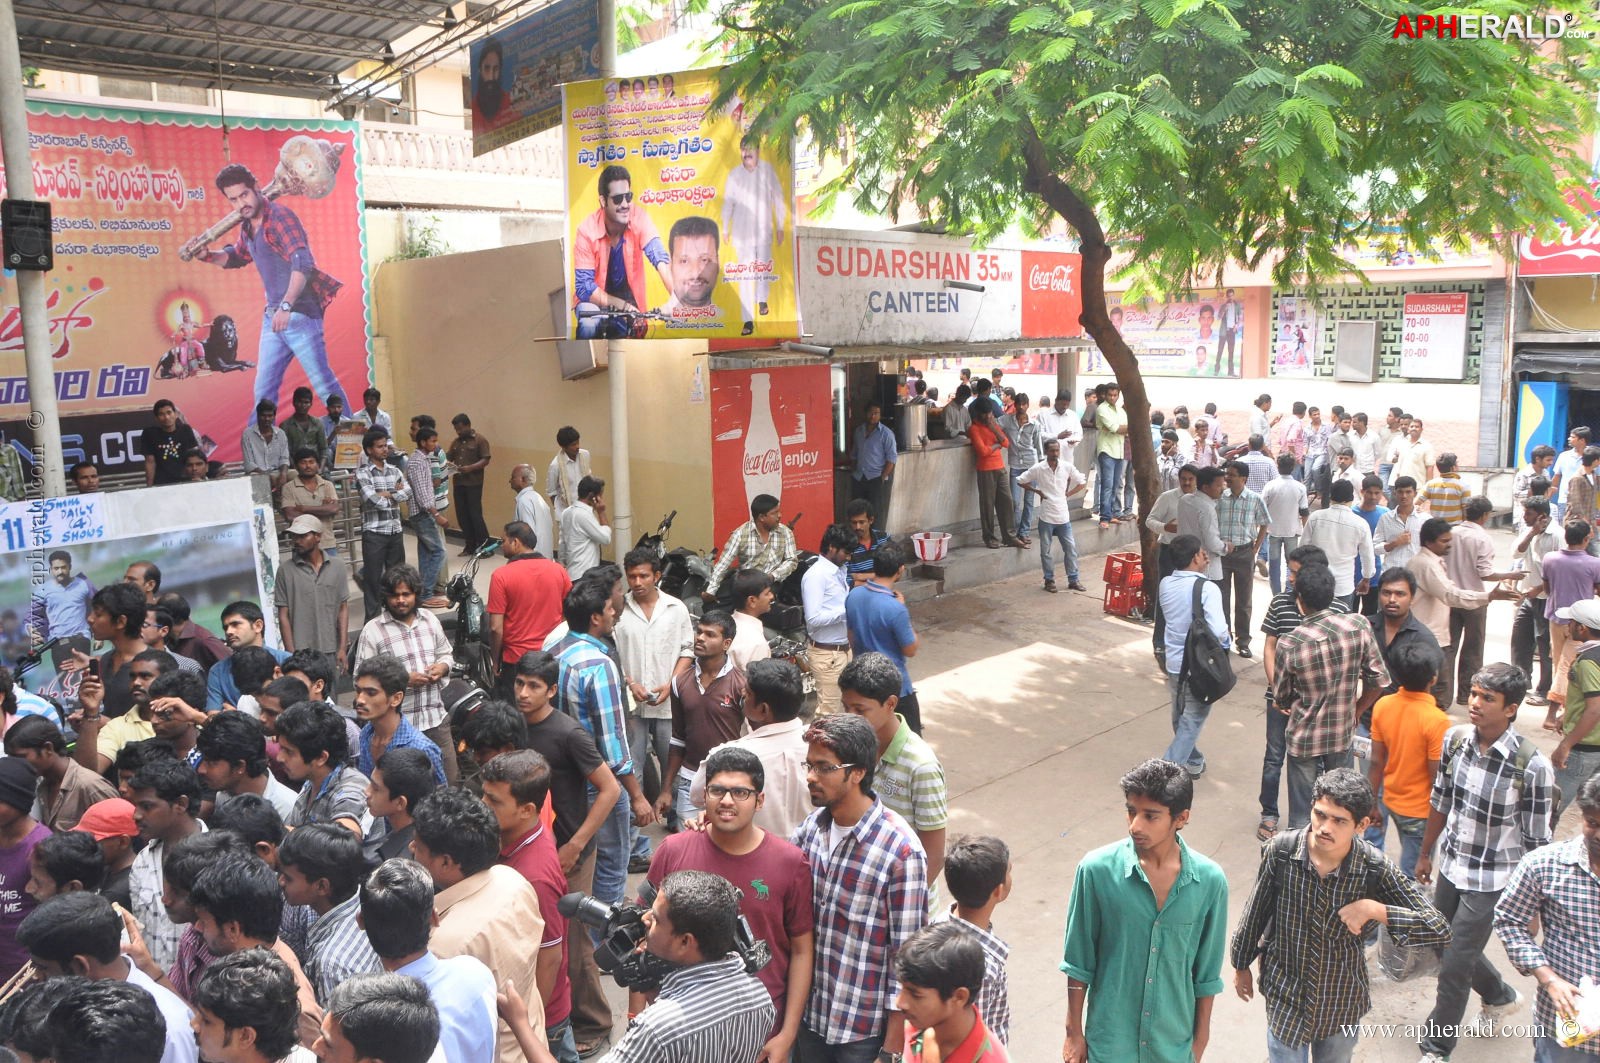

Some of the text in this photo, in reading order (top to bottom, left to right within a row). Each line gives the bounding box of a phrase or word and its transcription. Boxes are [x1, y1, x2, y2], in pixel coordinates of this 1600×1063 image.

[578, 144, 626, 167] స్వాగతం
[642, 136, 713, 161] సుస్వాగతం
[660, 167, 696, 183] దసరా
[151, 167, 185, 210] రావు
[639, 186, 716, 207] శుభాకాంక్షలు
[100, 218, 172, 232] అభిమానులకు
[55, 243, 160, 258] దసరా శుభాకాంక్షలు
[816, 245, 970, 281] SUDARSHAN
[868, 291, 959, 313] CANTEEN
[1406, 304, 1451, 313] SUDARSHAN
[1406, 318, 1430, 328] 70-00
[1405, 333, 1429, 343] 40-00
[1404, 348, 1428, 357] 20-00
[785, 449, 819, 467] enjoy
[61, 503, 94, 520] DAILY
[61, 525, 104, 543] SHOWS
